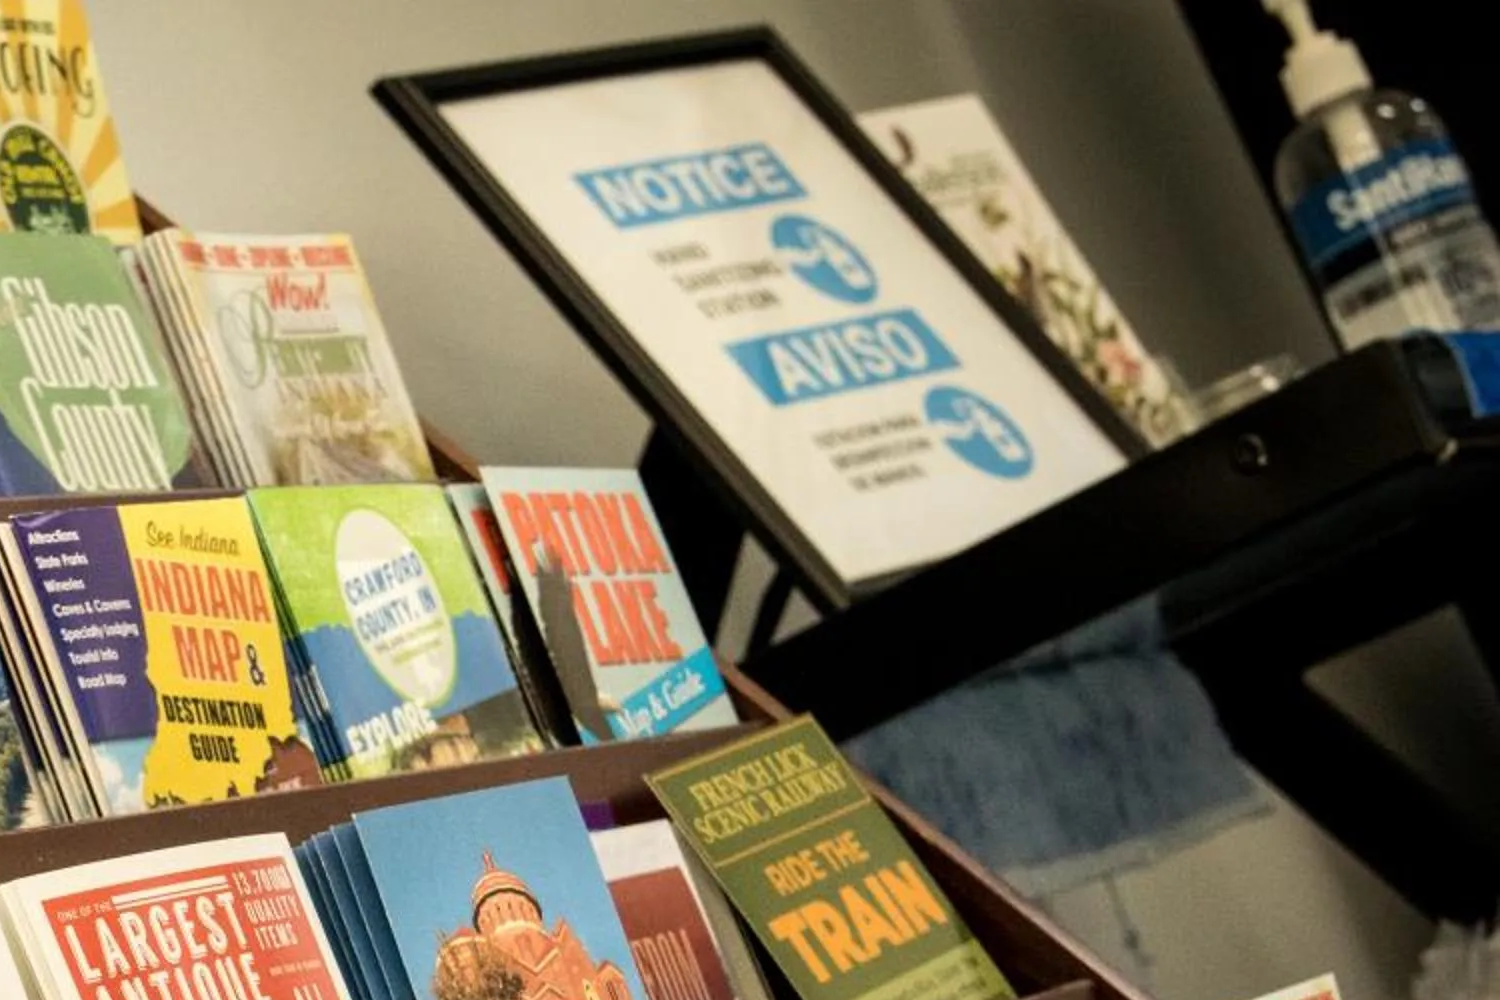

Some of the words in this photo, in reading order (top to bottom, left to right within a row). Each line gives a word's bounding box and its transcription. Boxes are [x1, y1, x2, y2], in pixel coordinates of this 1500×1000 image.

[592, 150, 791, 220] NOTICE
[1, 276, 158, 389] Gibson
[764, 313, 930, 397] AVISO
[19, 377, 173, 493] County
[27, 529, 80, 545] Attractions
[145, 520, 175, 549] See
[178, 523, 240, 556] Indiana
[501, 491, 672, 578] PATOKA
[134, 557, 272, 624] INDIANA
[343, 550, 425, 607] CRAWFORD
[415, 586, 438, 615] IN
[171, 624, 242, 683] MAP
[245, 643, 266, 687] &
[570, 579, 685, 667] LAKE
[161, 694, 268, 730] DESTINATION
[188, 732, 241, 764] GUIDE
[687, 758, 776, 812] FRENCH
[763, 742, 818, 783] LICK
[693, 794, 772, 844] SCENIC
[758, 760, 848, 817] RAILWAY
[764, 848, 827, 897] RIDE
[816, 830, 870, 872] THE
[64, 892, 249, 985] LARGEST
[243, 894, 300, 926] QUALITY
[253, 921, 299, 951] ITEMS
[768, 860, 949, 985] TRAIN
